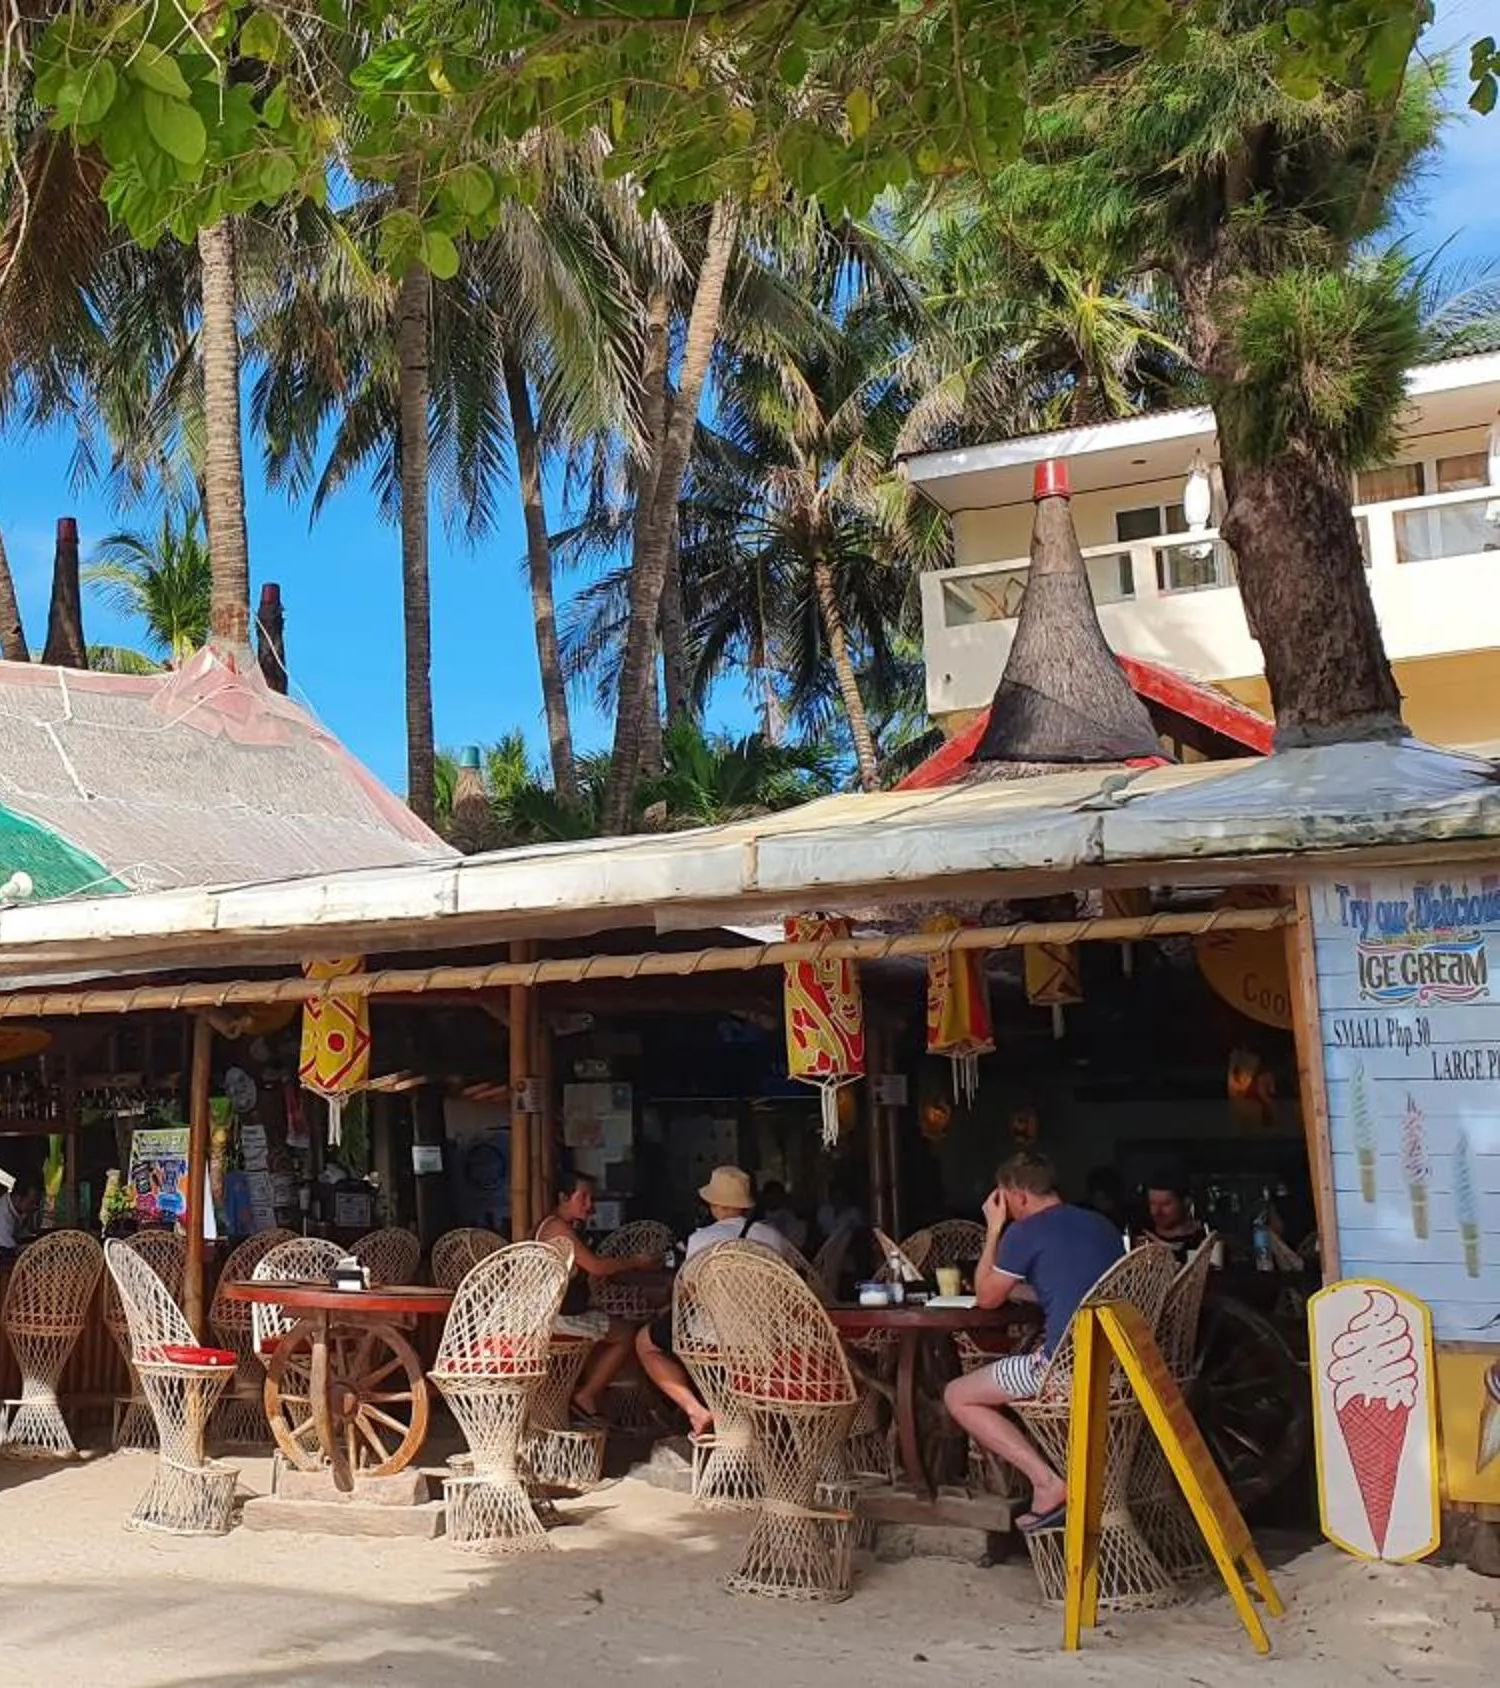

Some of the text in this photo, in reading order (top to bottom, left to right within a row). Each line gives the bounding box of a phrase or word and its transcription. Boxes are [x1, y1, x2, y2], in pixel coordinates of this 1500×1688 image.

[1334, 883, 1369, 940] Try
[1376, 901, 1409, 933] our
[1358, 952, 1396, 989] ICE
[1243, 973, 1291, 1017] Coo
[1334, 1018, 1384, 1048] SMALL
[1386, 1017, 1412, 1057] Php
[1432, 1051, 1485, 1080] LARGE
